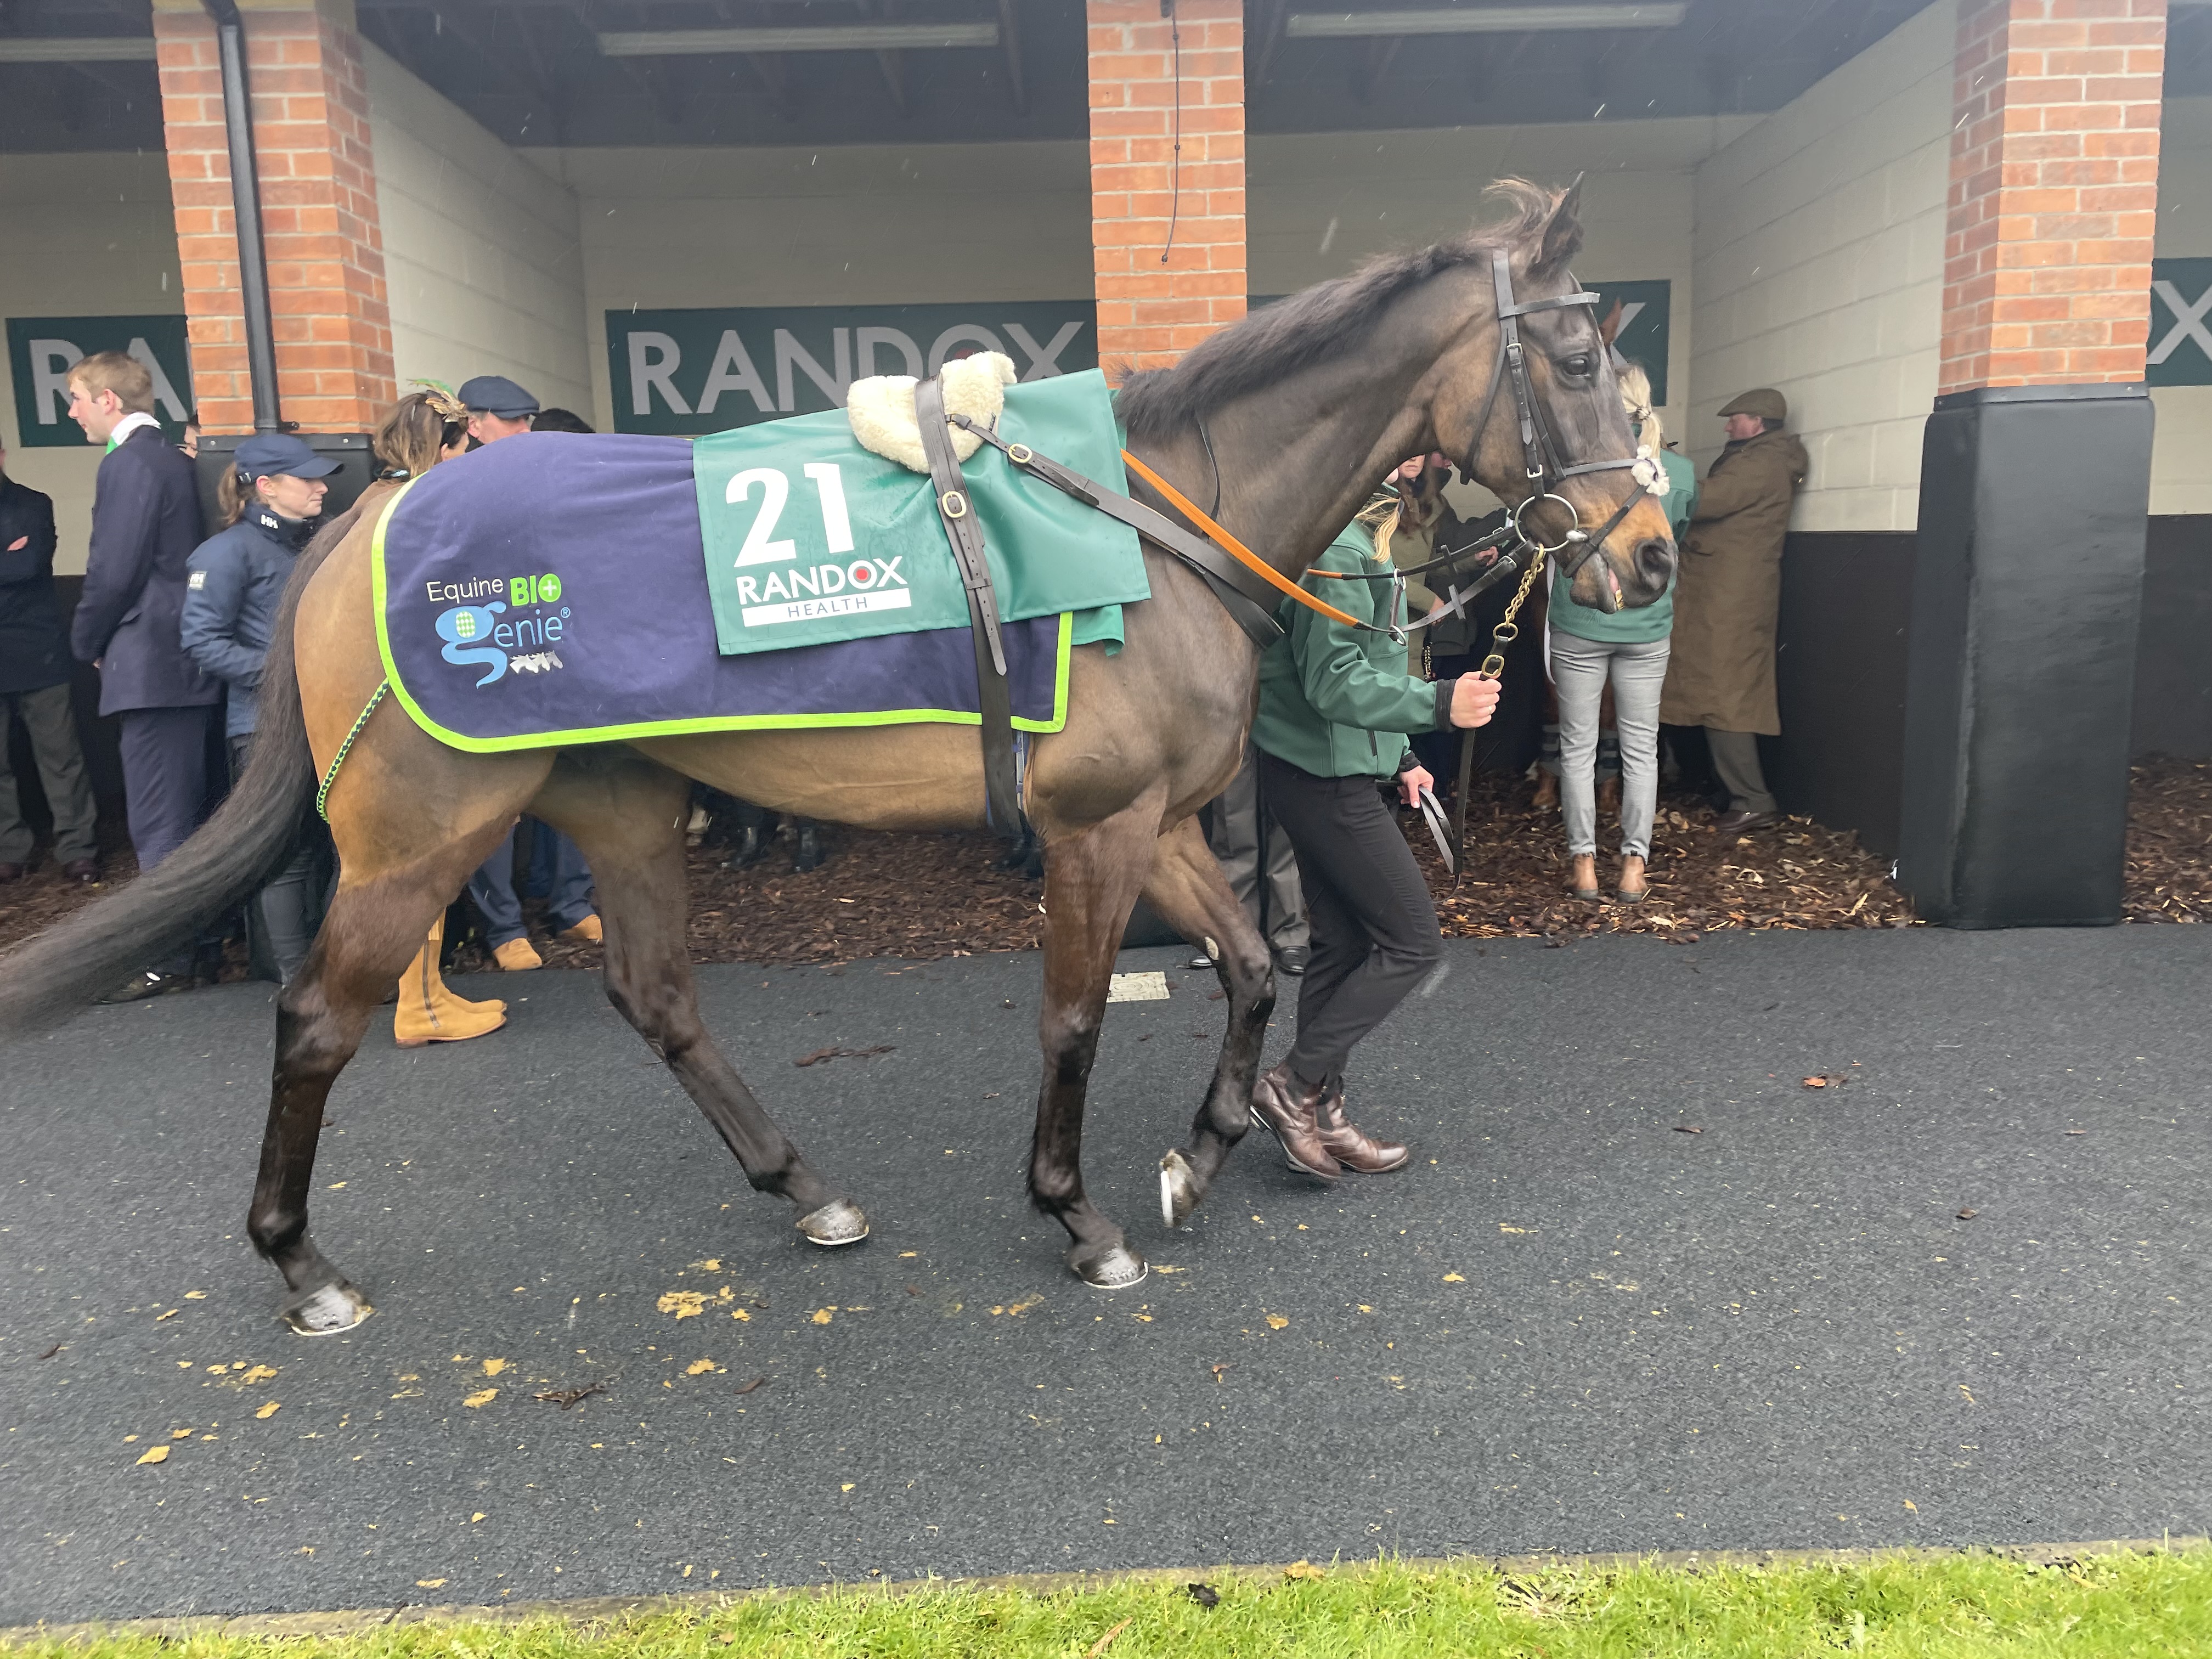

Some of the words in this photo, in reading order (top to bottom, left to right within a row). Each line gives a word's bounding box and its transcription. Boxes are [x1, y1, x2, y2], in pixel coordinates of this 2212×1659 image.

[2146, 280, 2212, 365] X
[30, 337, 196, 425] RA
[261, 515, 278, 529] HH
[726, 462, 854, 568] 21
[426, 577, 503, 603] Equine
[736, 556, 908, 605] RANDOX
[787, 596, 867, 618] HEALTH
